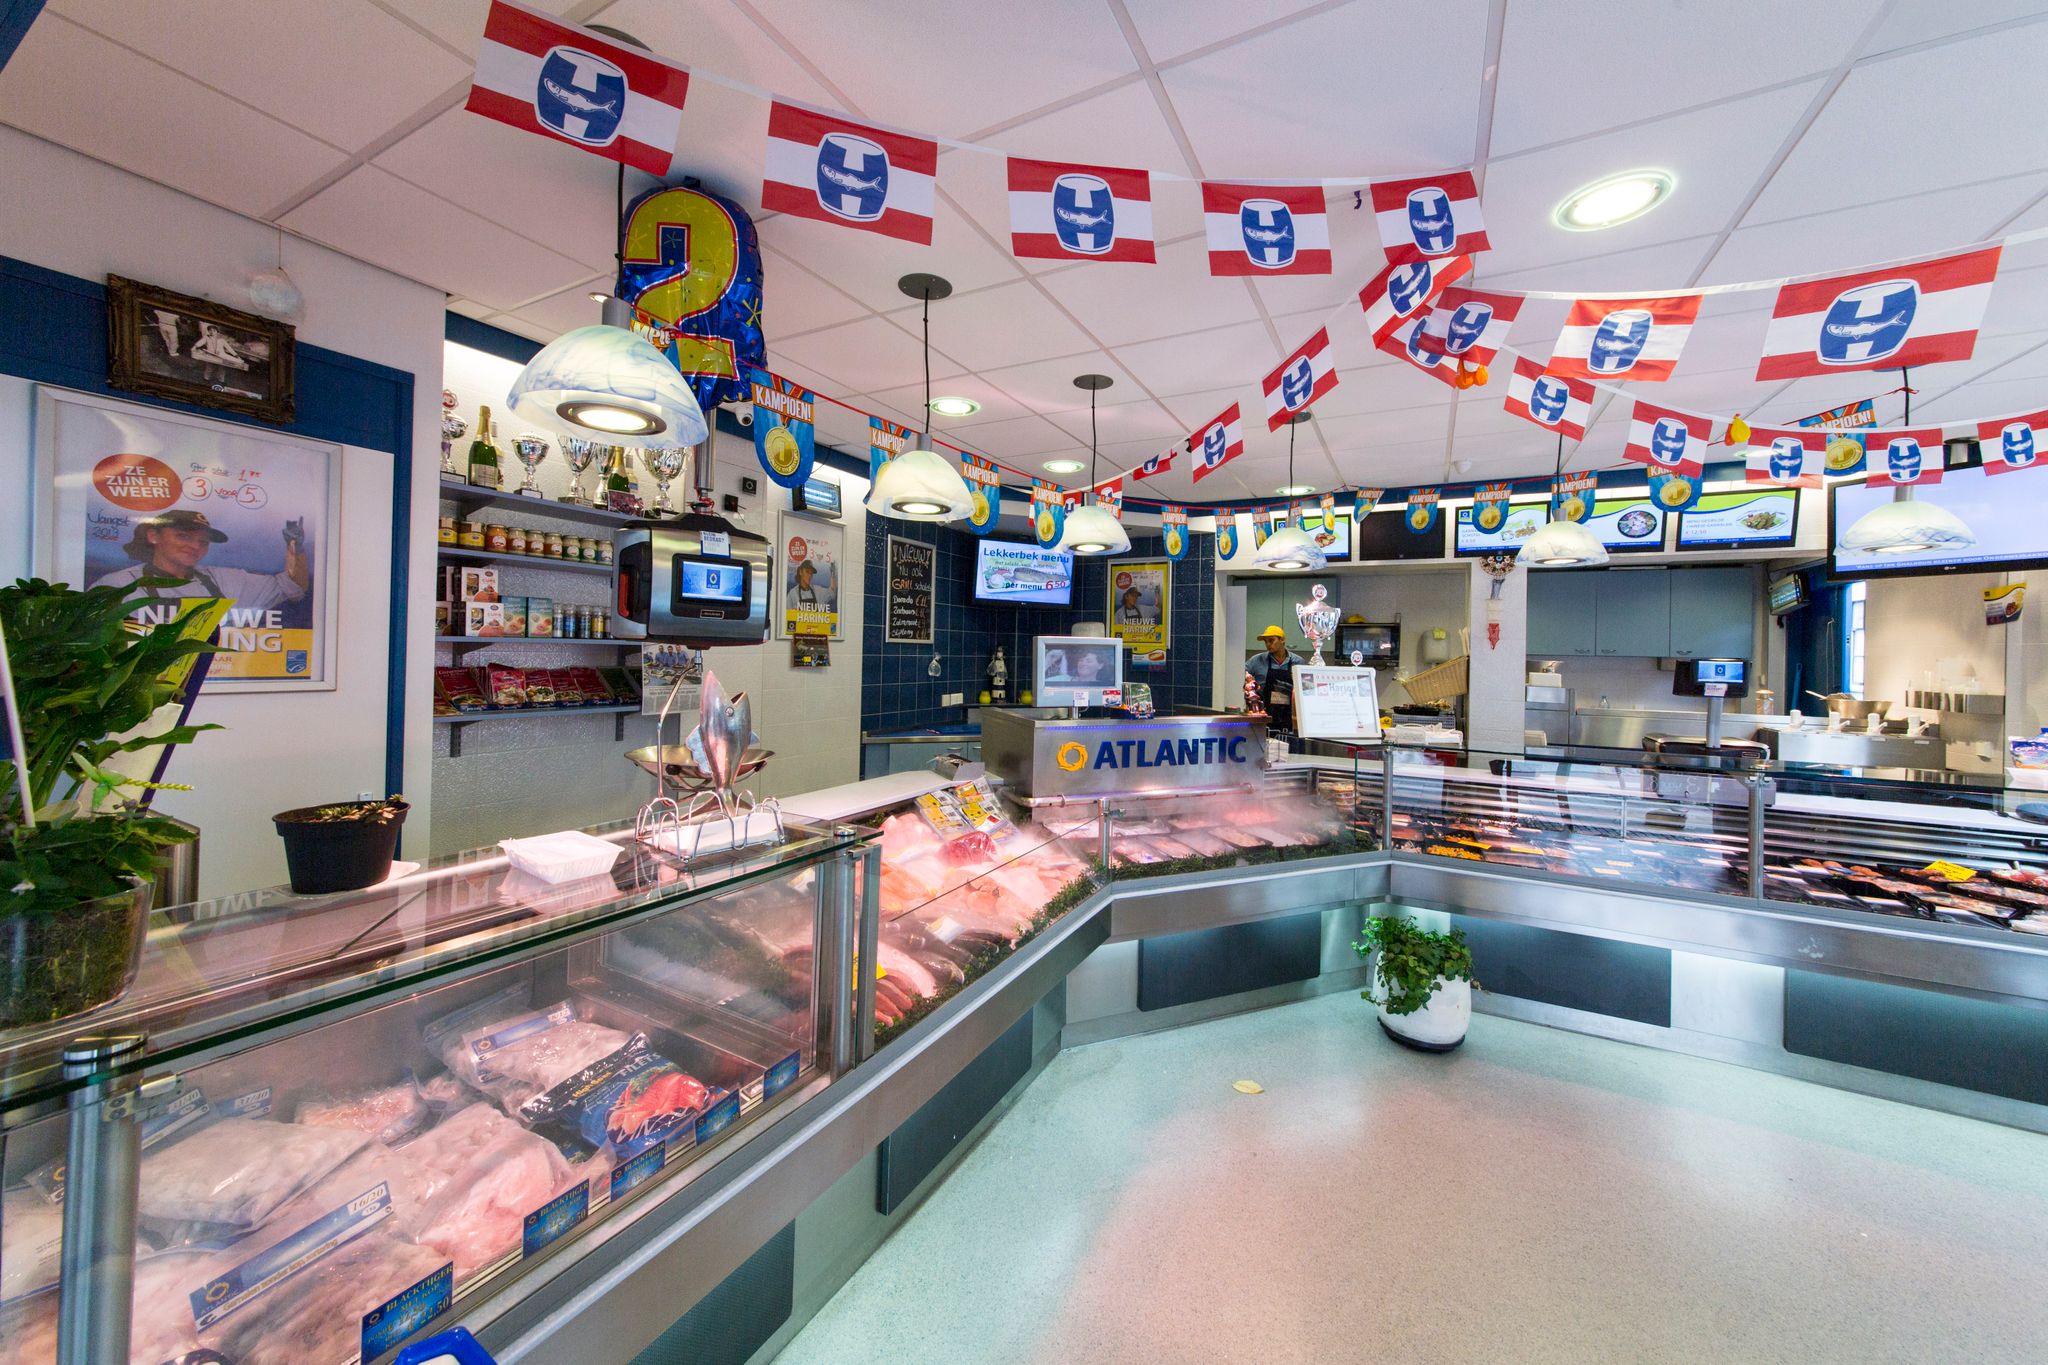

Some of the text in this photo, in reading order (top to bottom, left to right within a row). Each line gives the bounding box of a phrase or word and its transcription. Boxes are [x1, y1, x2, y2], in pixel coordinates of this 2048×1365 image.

[755, 384, 811, 422] KAMPIOEN!
[1810, 411, 1872, 429] AMPIOEN!
[124, 465, 147, 476] ZE
[963, 462, 998, 486] KAMPIOEN!
[105, 475, 169, 487] ZIJN ER
[191, 478, 207, 497] 3
[109, 486, 172, 498] WEER!
[1475, 490, 1512, 502] KAMPIOEN!
[983, 547, 1069, 563] Lekkerbek menu
[137, 604, 283, 629] NIWE
[796, 602, 831, 614] NIEUWE
[797, 613, 830, 624] HARING
[1123, 618, 1156, 626] NIEUWE
[1093, 735, 1247, 770] ATLANTIC
[352, 1188, 384, 1212] 16/20
[386, 1265, 453, 1313] BLACKTIJGER
